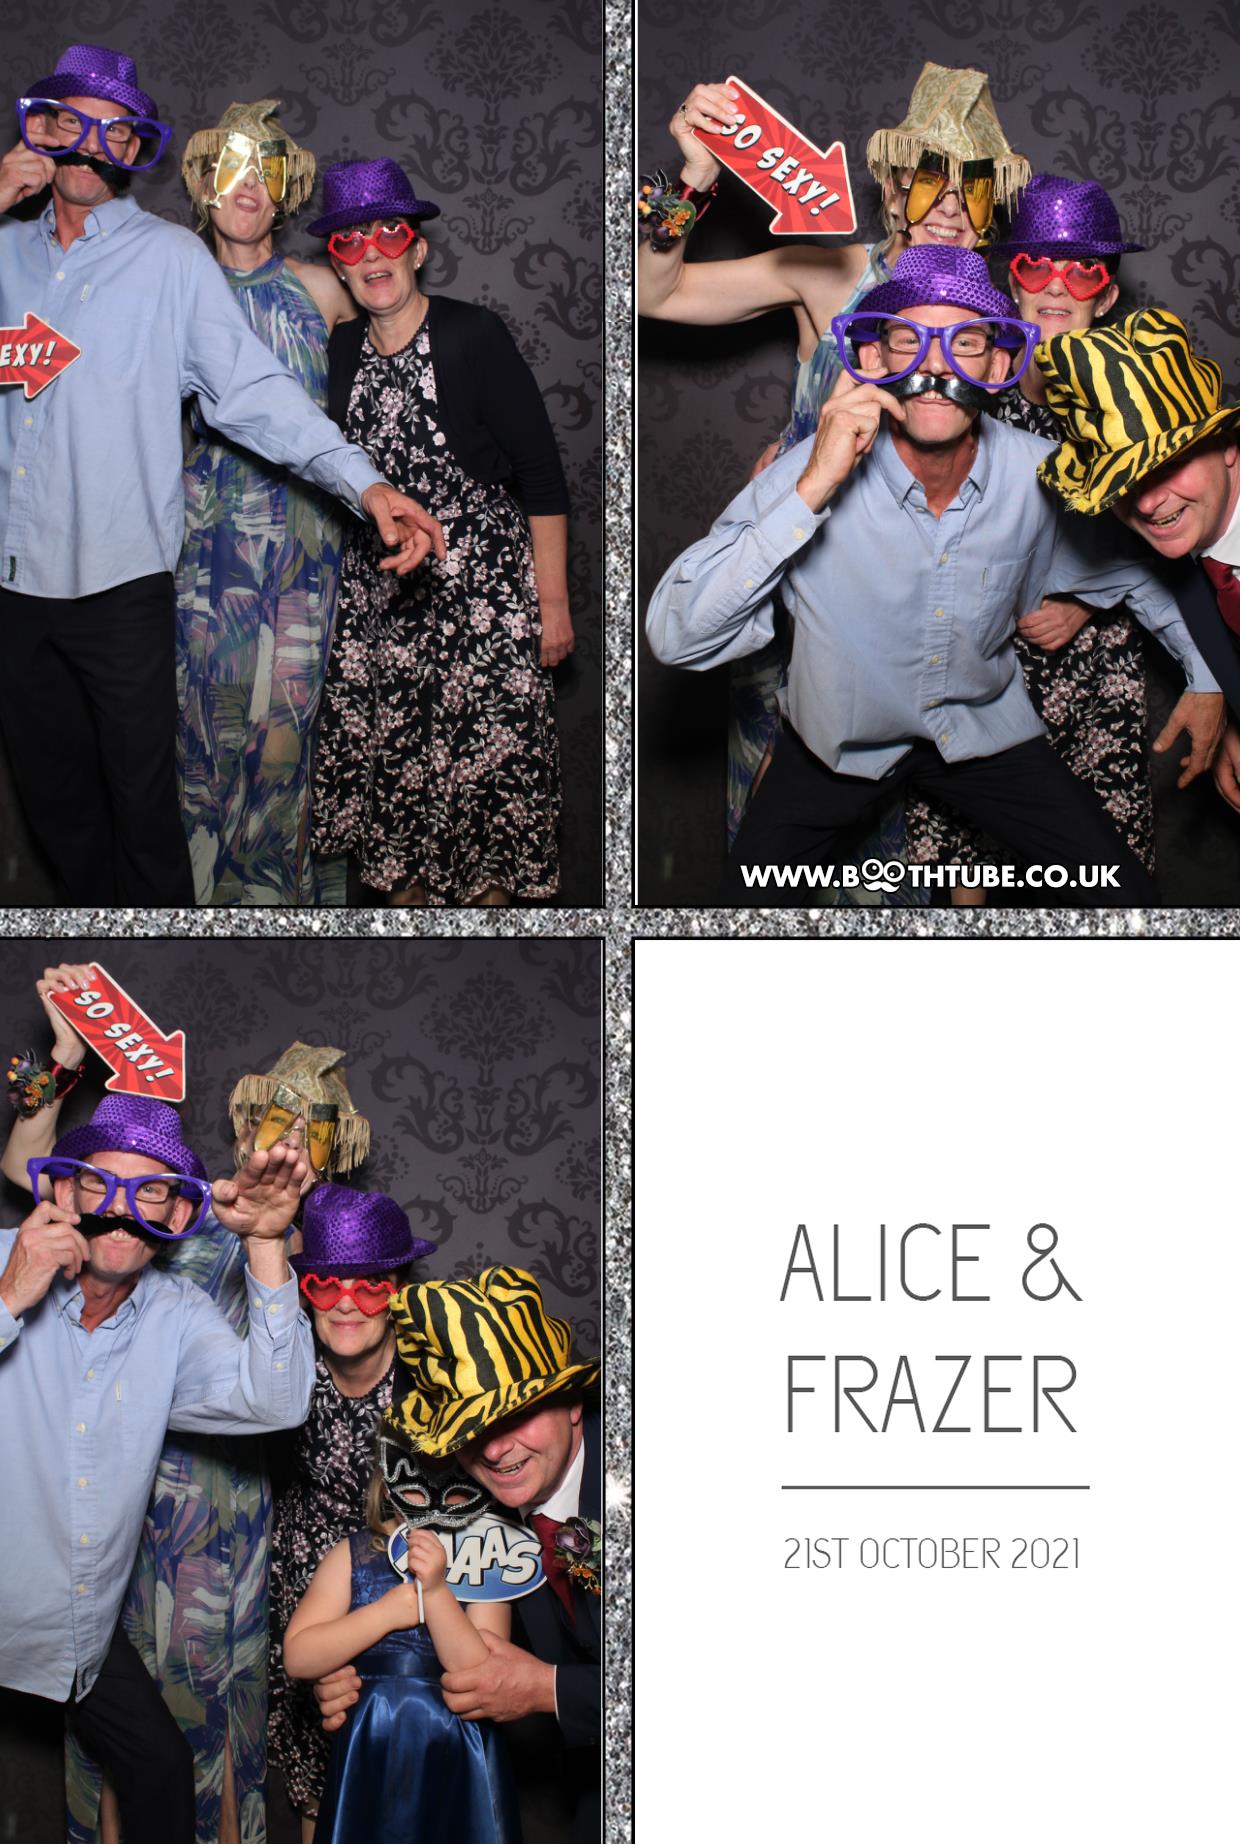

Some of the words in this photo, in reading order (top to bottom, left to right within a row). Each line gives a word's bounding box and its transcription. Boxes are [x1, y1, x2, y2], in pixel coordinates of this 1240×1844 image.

[756, 147, 841, 216] SEXY!
[73, 990, 115, 1019] SO
[103, 1022, 175, 1082] SEXY!
